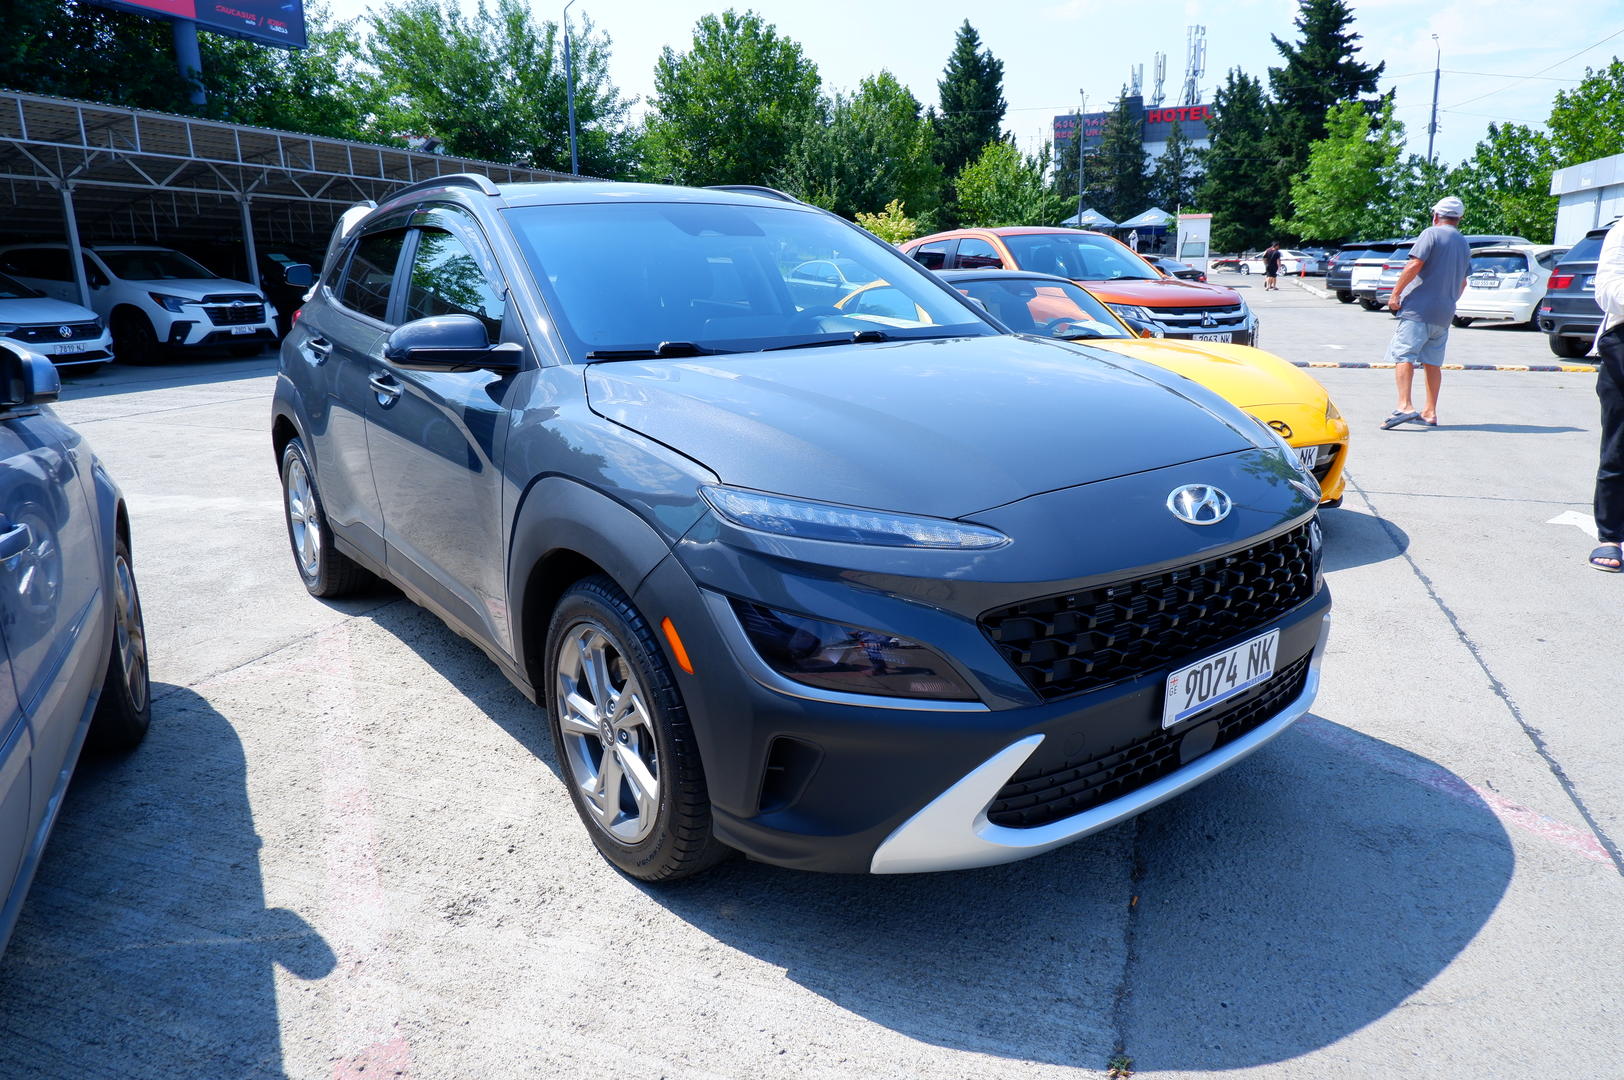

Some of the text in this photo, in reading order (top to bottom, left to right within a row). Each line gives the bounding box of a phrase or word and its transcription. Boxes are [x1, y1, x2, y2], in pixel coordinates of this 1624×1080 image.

[215, 5, 257, 21] CAUCASUS
[1148, 106, 1214, 124] HOTEL
[1220, 333, 1231, 344] NK
[1300, 447, 1316, 465] NK
[1184, 635, 1275, 710] 9074 NK
